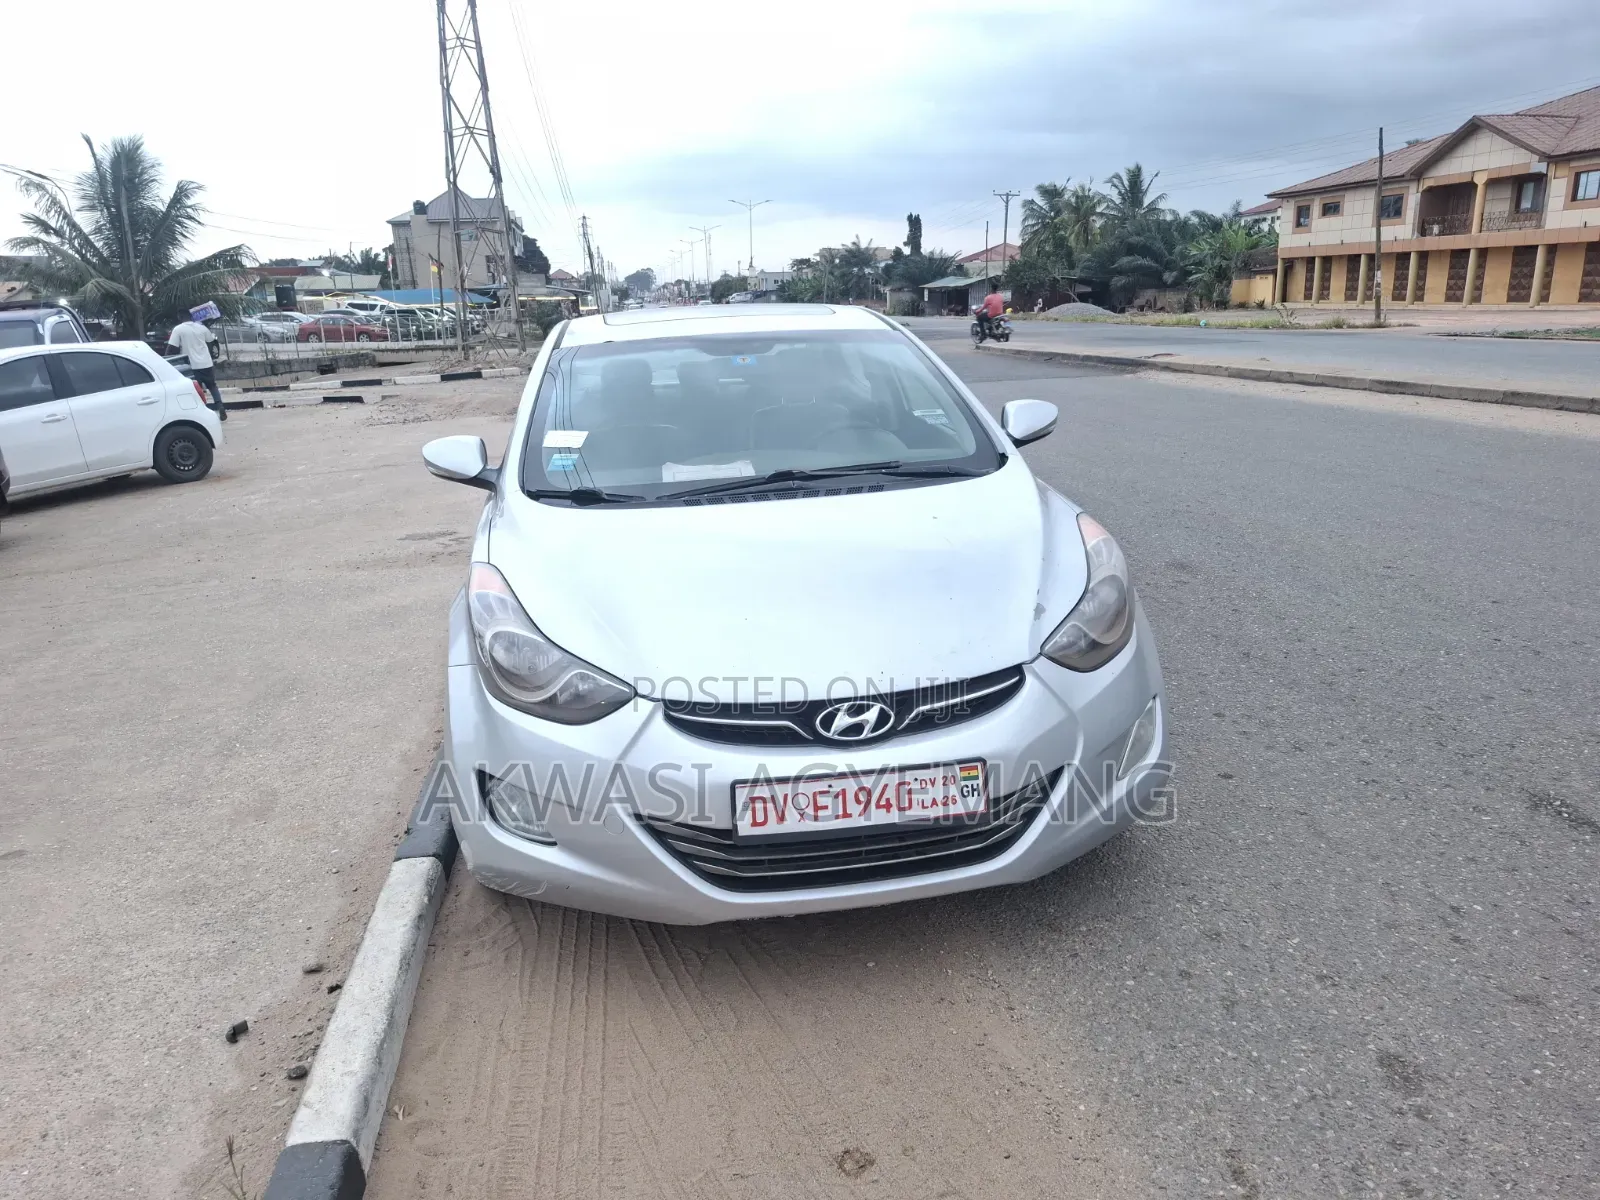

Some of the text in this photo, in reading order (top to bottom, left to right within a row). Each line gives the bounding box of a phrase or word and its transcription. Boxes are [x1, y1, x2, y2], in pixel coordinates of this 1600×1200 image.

[919, 774, 956, 790] DV 20
[960, 783, 981, 798] GH
